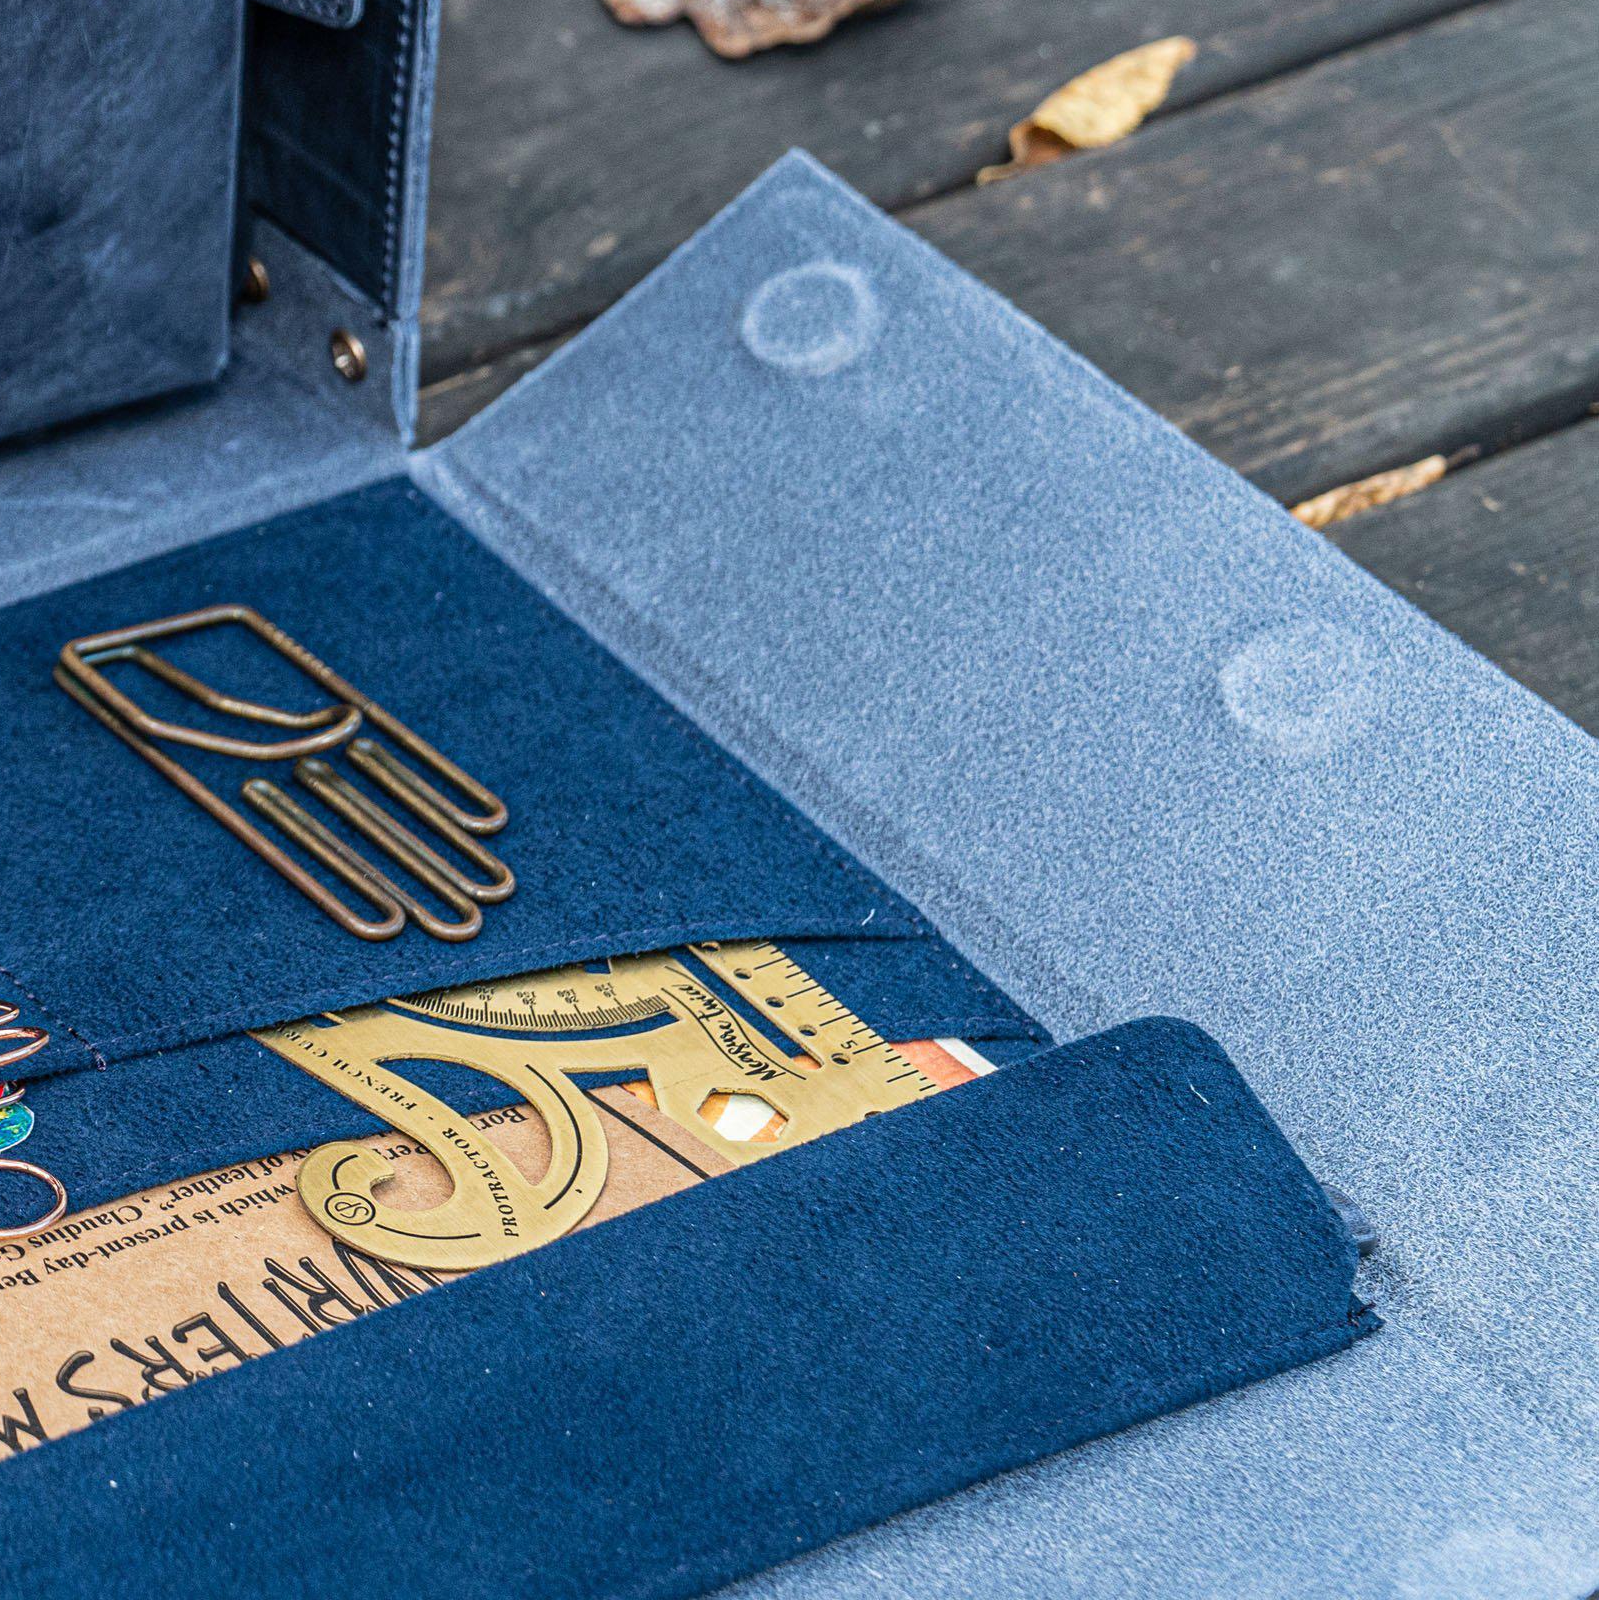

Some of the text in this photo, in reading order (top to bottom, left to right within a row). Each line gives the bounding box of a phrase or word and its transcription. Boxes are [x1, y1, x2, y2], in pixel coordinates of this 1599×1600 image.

[718, 1019, 787, 1082] Measure
[840, 1039, 858, 1050] 5
[331, 1058, 418, 1112] FRENCH
[256, 1156, 284, 1177] of
[441, 1127, 520, 1237] PROTRACTOR
[192, 1209, 221, 1226] is
[217, 1182, 297, 1217] which
[26, 1204, 144, 1249] Claudius
[42, 1213, 192, 1277] present-day
